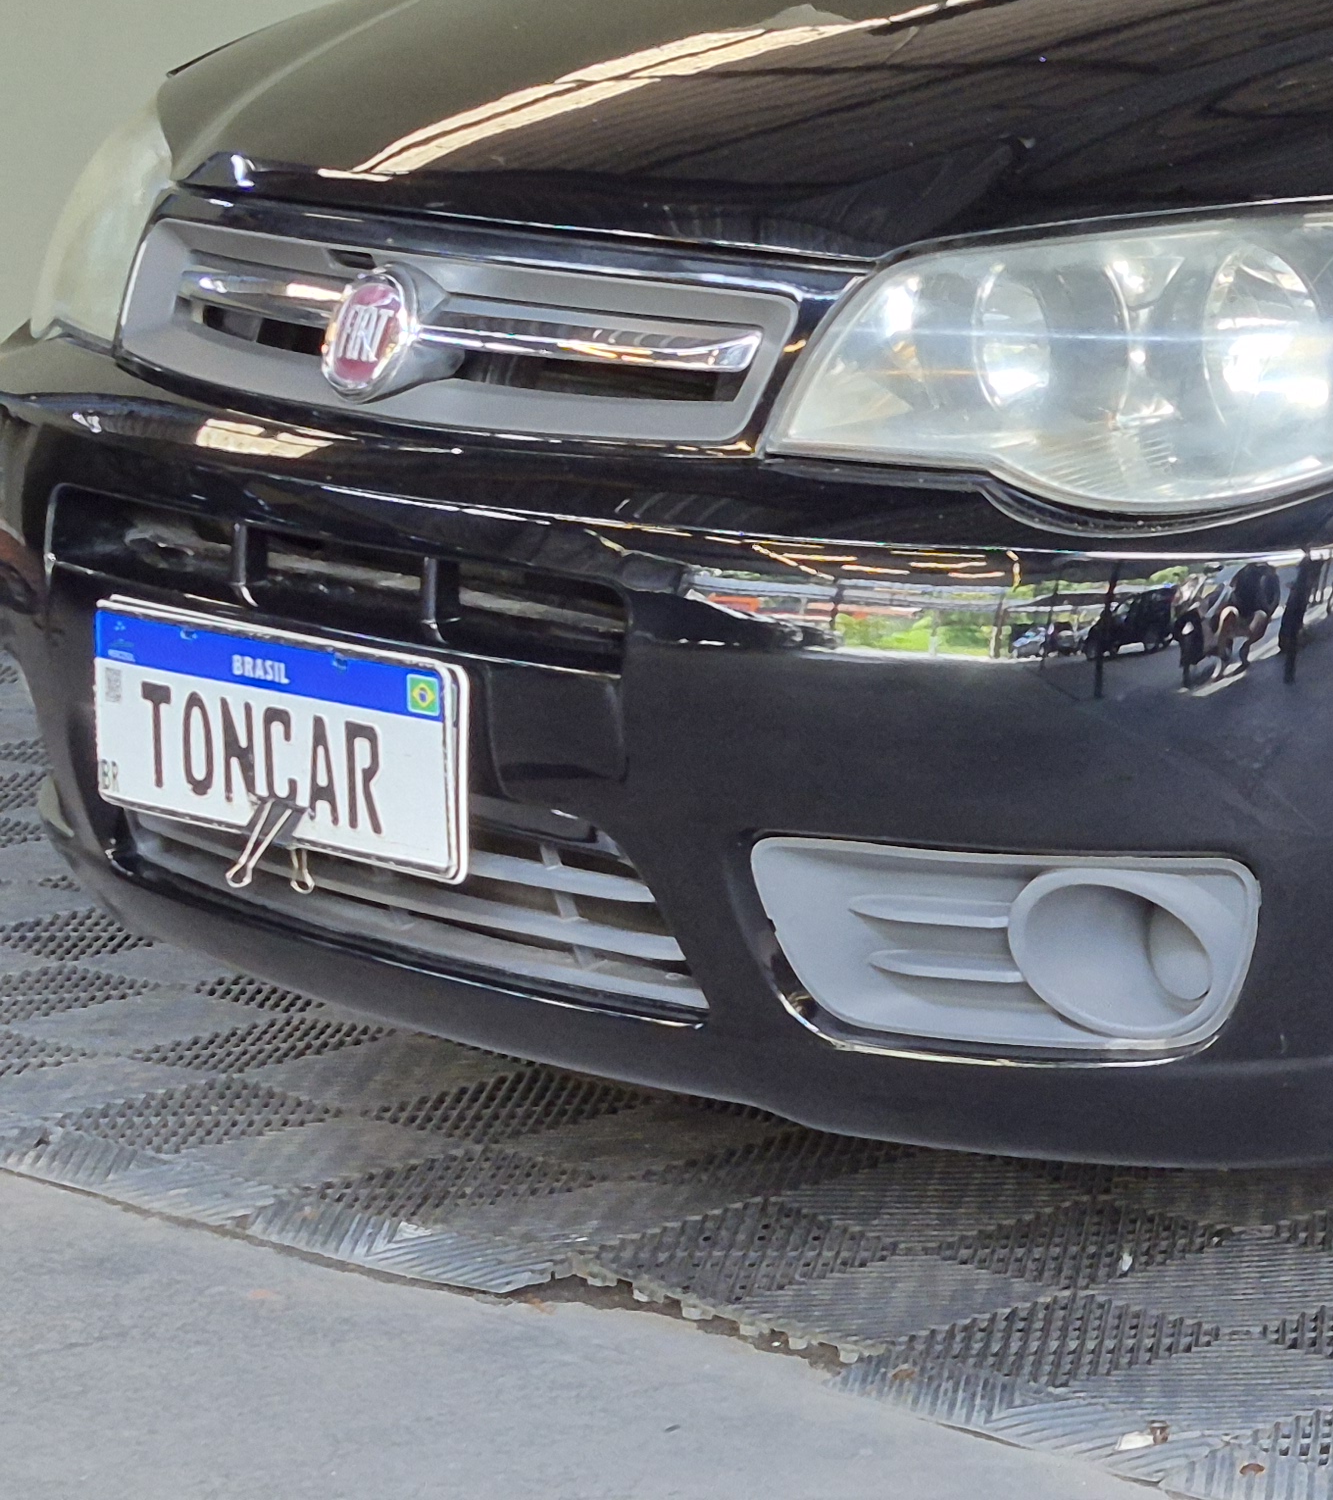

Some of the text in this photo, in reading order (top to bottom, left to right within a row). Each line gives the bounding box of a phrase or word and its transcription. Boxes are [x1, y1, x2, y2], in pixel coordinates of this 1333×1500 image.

[336, 304, 395, 362] FIAT
[231, 653, 290, 684] BRASIL
[100, 758, 120, 793] BR
[140, 680, 383, 835] TONCAR
